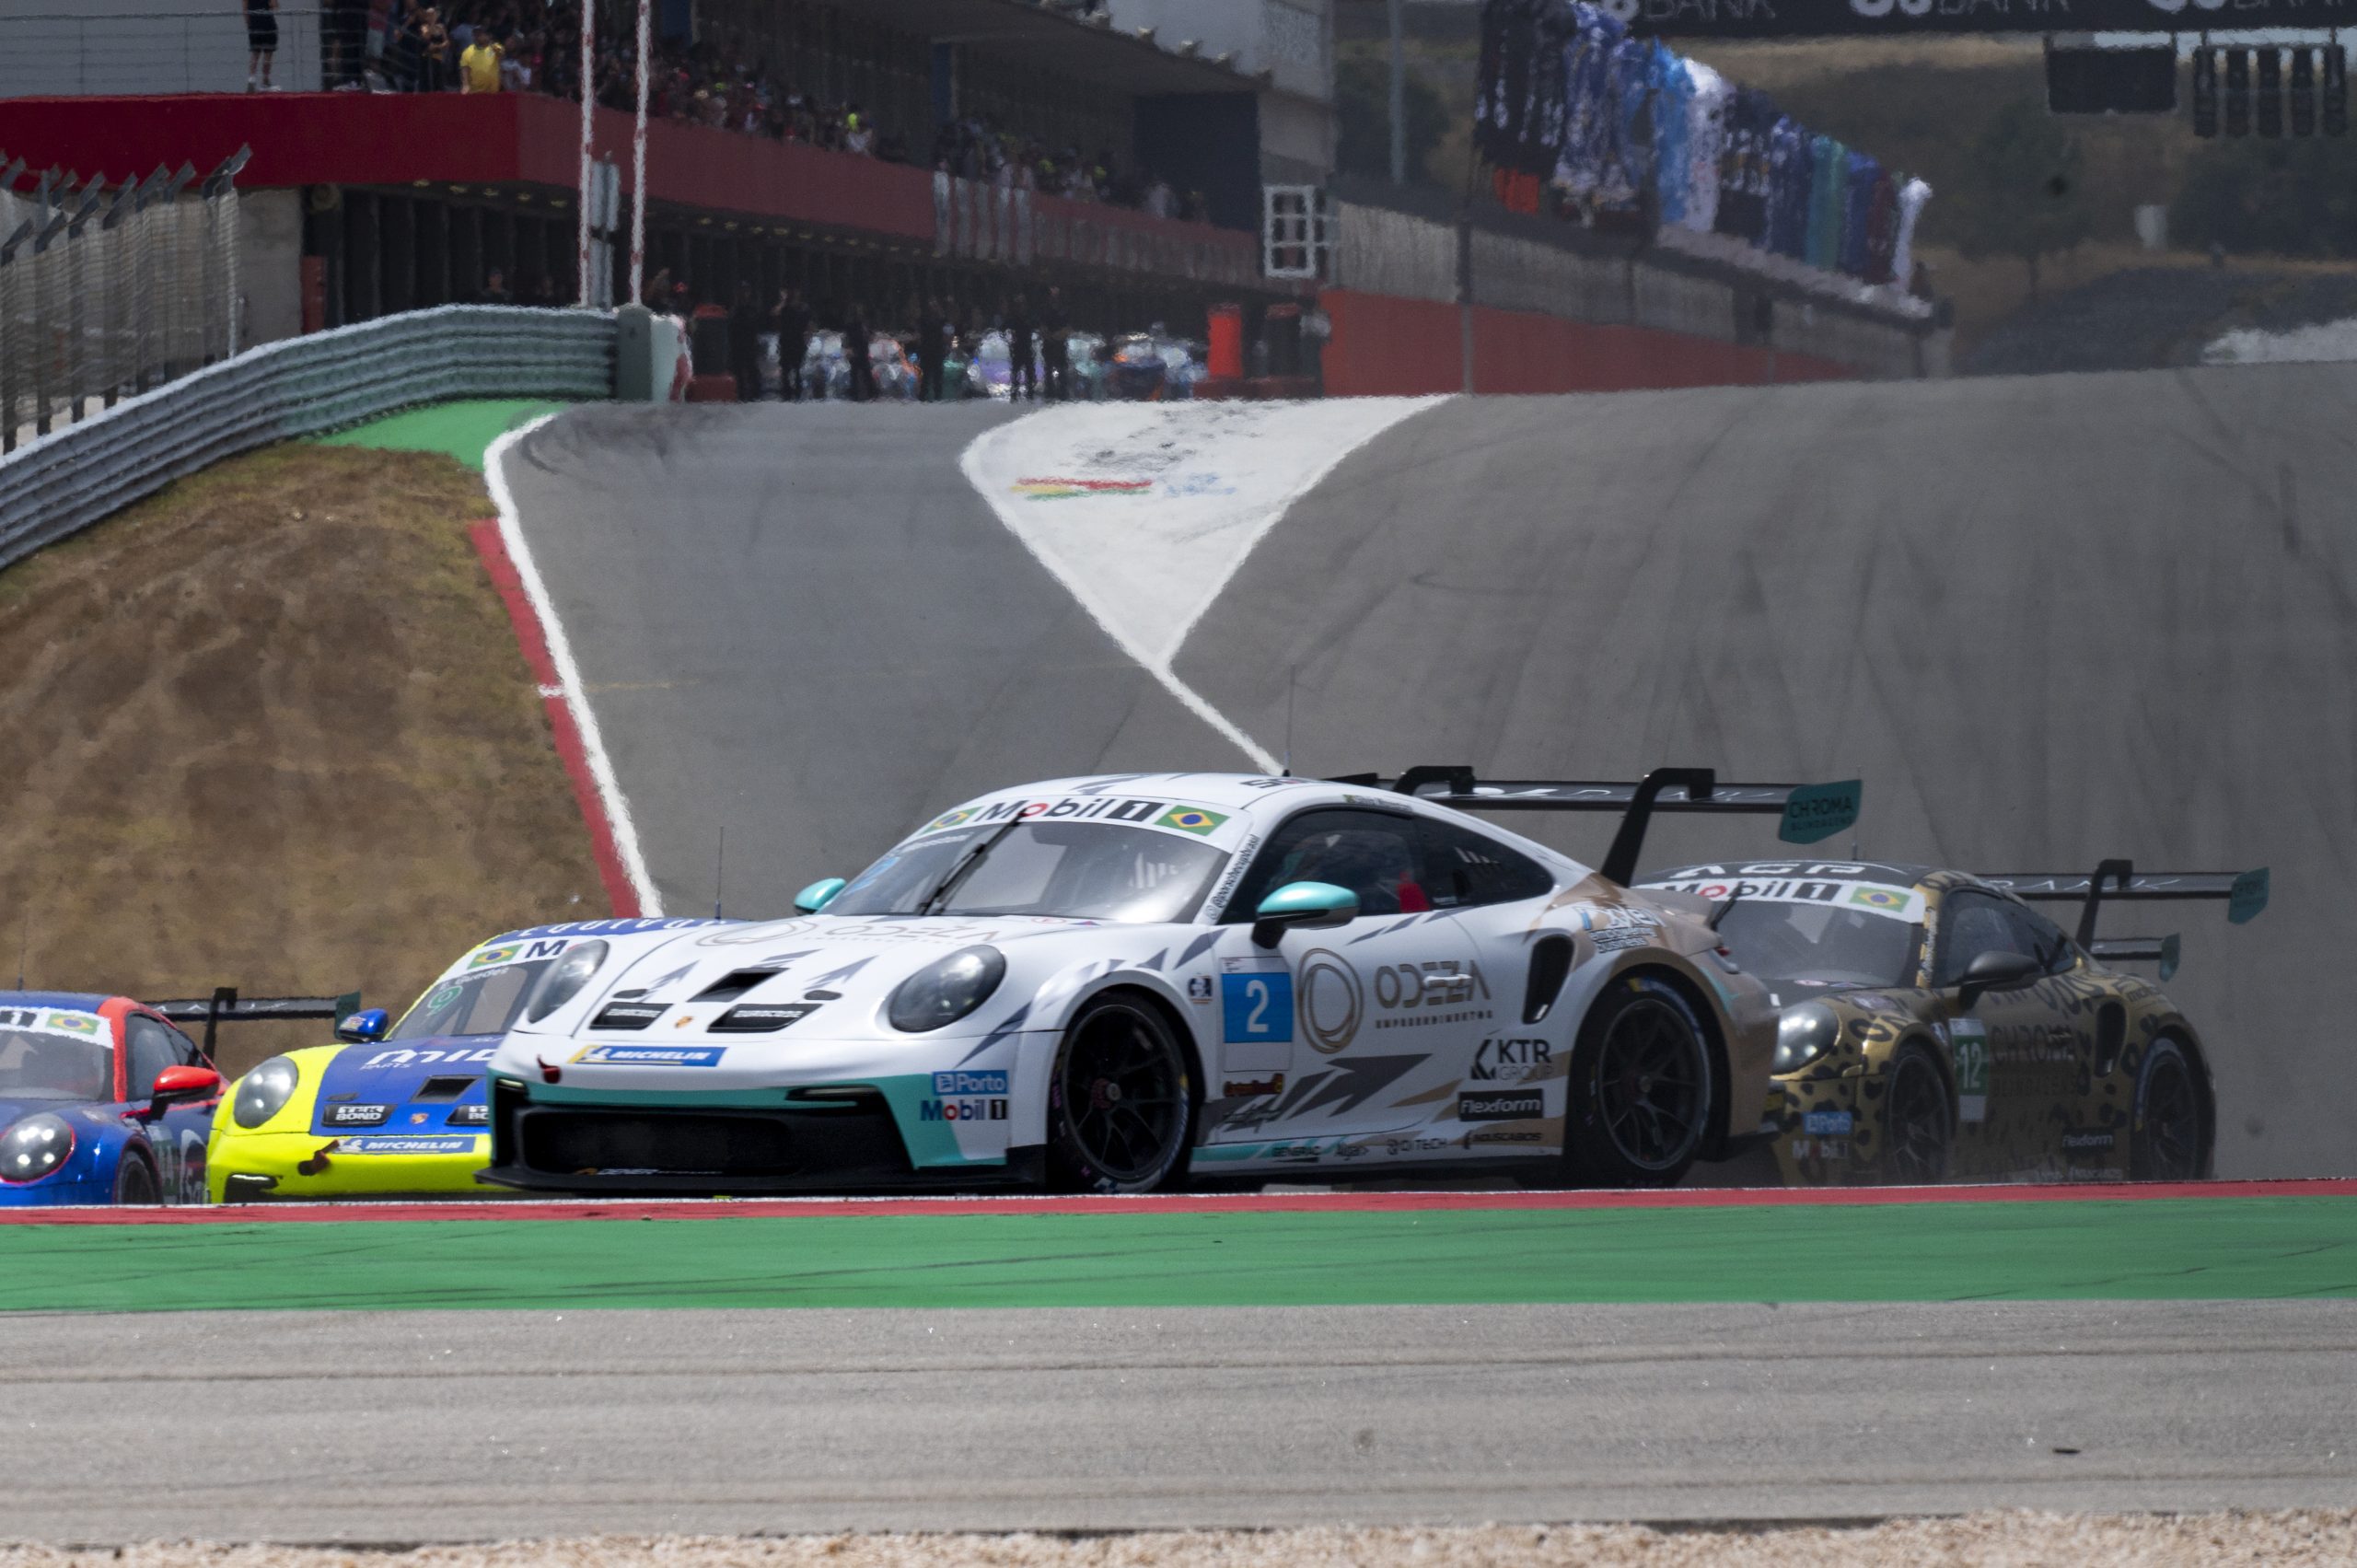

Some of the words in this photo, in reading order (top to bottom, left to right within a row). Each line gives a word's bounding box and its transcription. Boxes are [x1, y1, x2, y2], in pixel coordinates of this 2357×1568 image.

[974, 797, 1117, 822] Mobil
[1246, 979, 1270, 1033] 2
[610, 1050, 711, 1061] MICHELIN
[1498, 1039, 1552, 1063] KTR
[1497, 1065, 1554, 1080] GROUP
[1960, 1042, 1981, 1089] 12
[957, 1074, 1005, 1091] Porto
[335, 1112, 382, 1121] BOND
[921, 1099, 985, 1121] Mobil
[366, 1141, 463, 1150] MICHELIN
